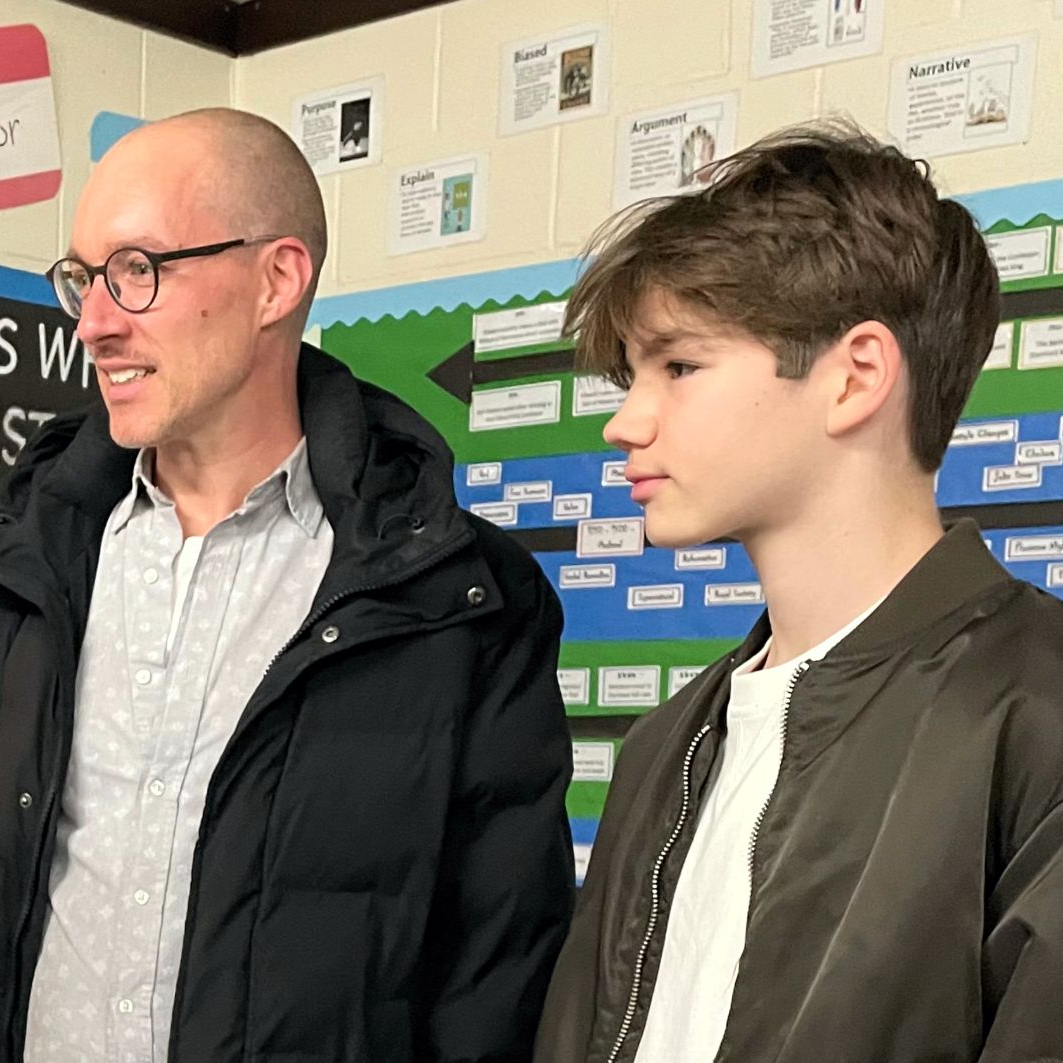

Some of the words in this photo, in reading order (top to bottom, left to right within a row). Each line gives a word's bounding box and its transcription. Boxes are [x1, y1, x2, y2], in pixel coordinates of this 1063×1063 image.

[909, 57, 971, 79] Narrative
[631, 113, 687, 135] Argument
[400, 170, 435, 187] Explain
